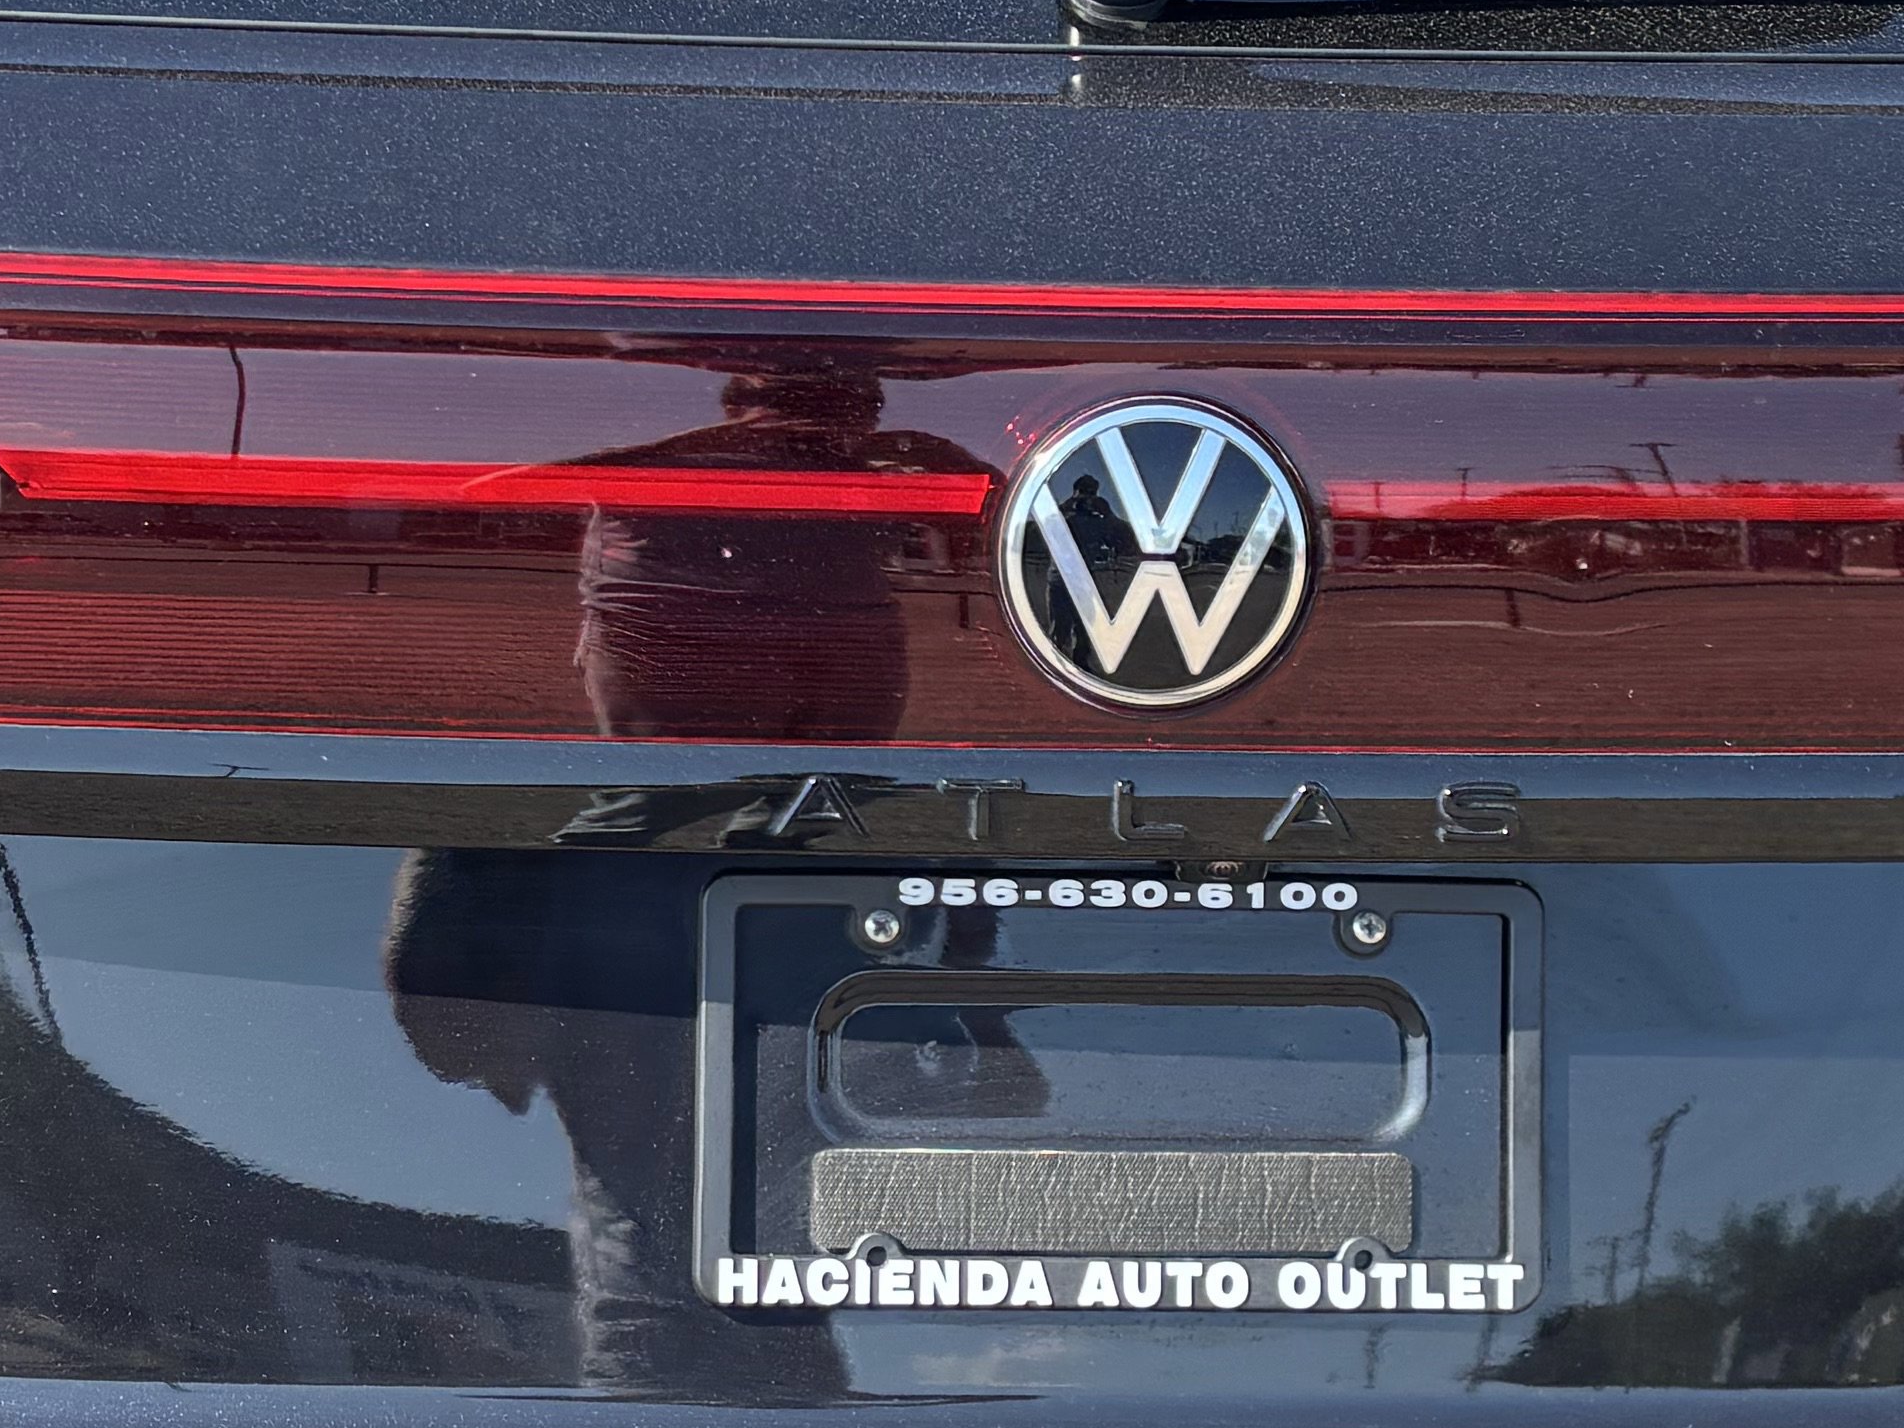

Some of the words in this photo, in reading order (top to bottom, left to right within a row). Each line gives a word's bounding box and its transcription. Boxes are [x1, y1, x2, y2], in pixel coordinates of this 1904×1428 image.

[1030, 426, 1287, 676] VW
[766, 774, 1523, 844] ATLAS
[897, 875, 1359, 912] 956-630-6100
[717, 1257, 1059, 1308] HACIENDA
[1076, 1262, 1252, 1309] AUTO
[1277, 1263, 1525, 1310] OUTLET
